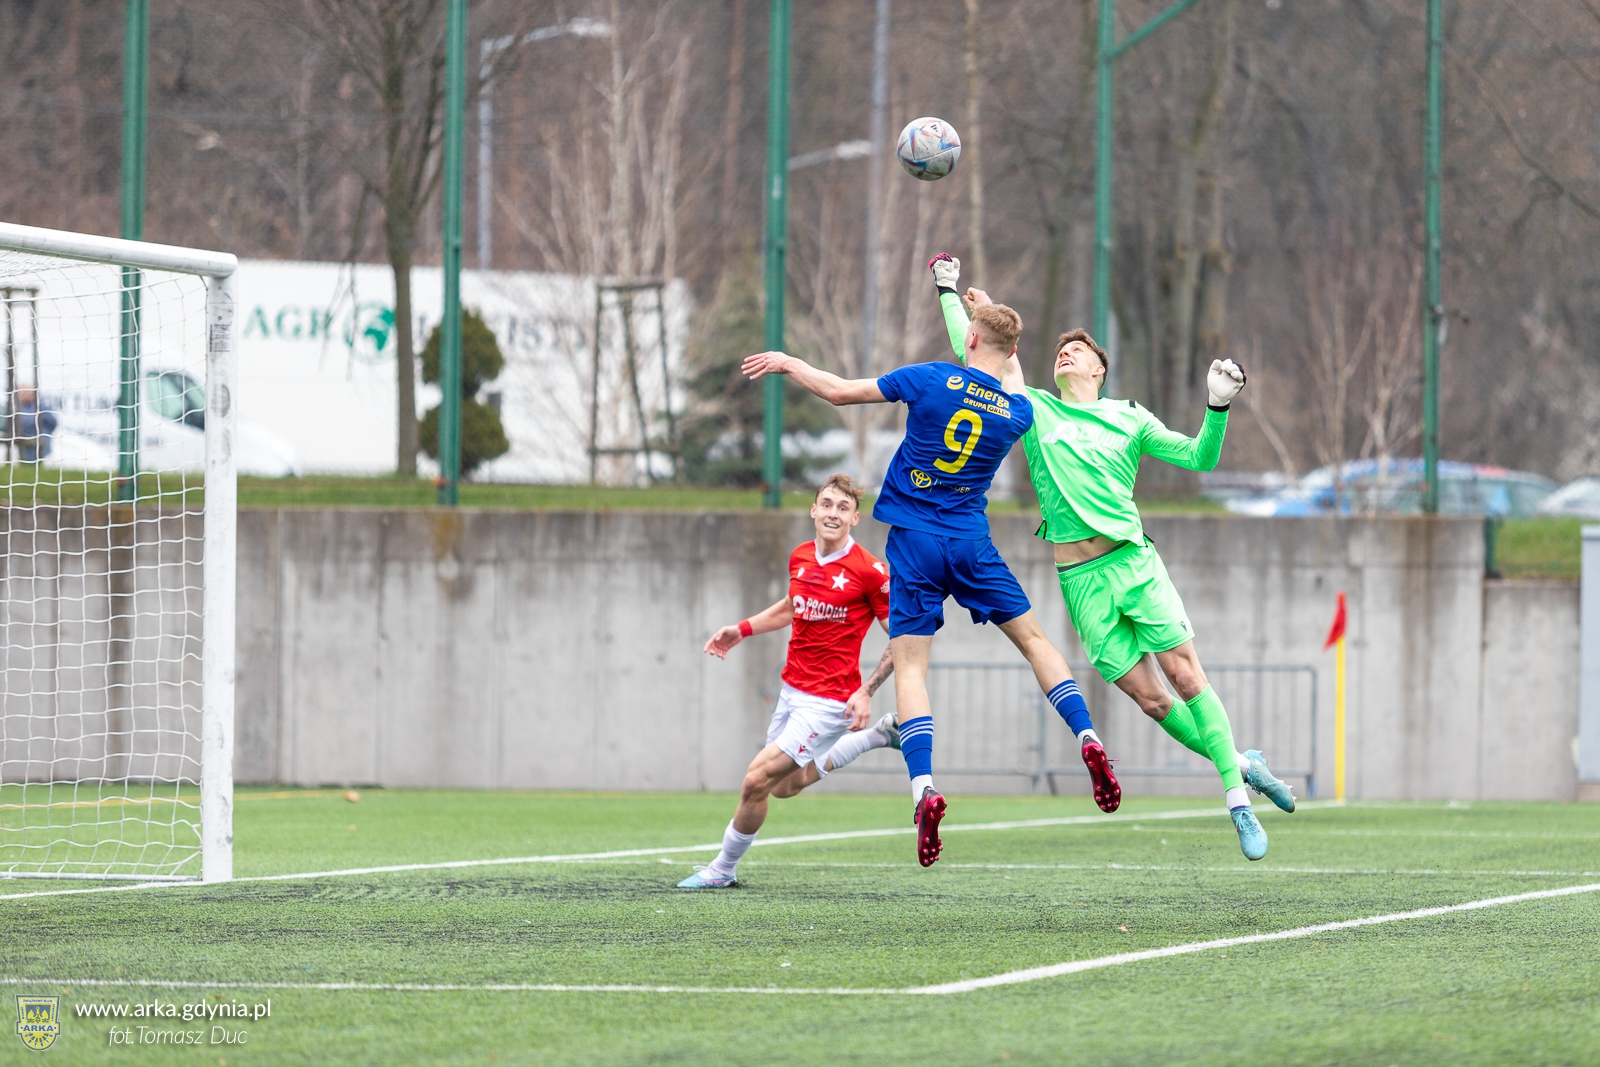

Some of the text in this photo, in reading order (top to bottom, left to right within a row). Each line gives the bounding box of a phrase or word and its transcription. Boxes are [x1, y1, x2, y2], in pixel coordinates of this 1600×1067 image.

[963, 397, 1011, 419] GRUPA ORLEN
[966, 382, 1010, 409] Energa
[933, 409, 983, 474] 9
